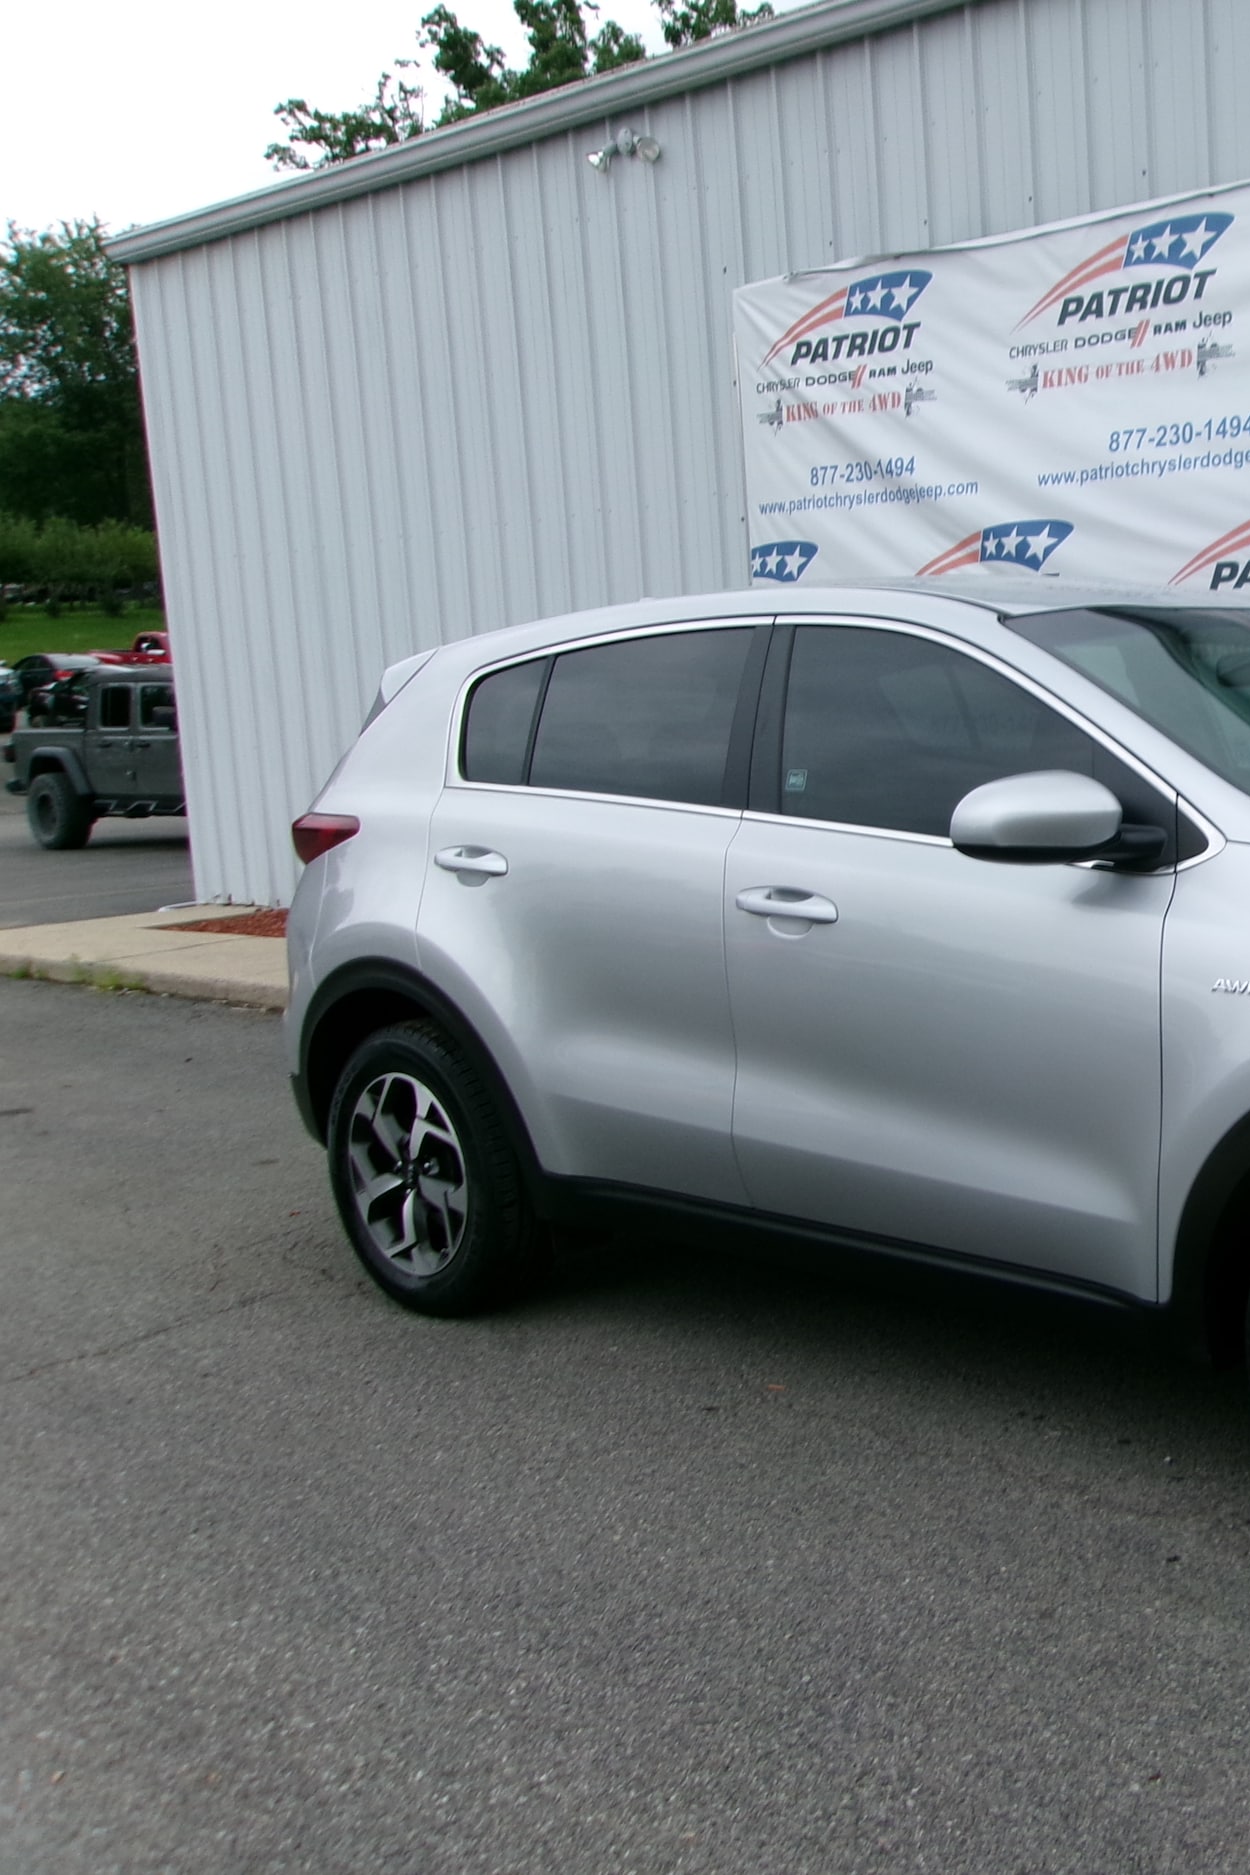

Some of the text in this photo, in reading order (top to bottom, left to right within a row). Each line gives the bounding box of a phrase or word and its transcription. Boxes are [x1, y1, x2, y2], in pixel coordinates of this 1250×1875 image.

[1057, 267, 1217, 326] PATRIOT
[790, 321, 921, 366] PATRIOT
[1009, 310, 1232, 360] CHRYSLER DODGE RAM Jeep
[805, 371, 856, 386] DODGE
[869, 366, 897, 379] RAM
[901, 359, 933, 376] Jeep
[1042, 349, 1193, 389] KING OF THE 4WD
[786, 391, 901, 422] KING OF THE 4WD
[810, 456, 915, 486] 877-230-1494
[759, 481, 978, 515] www.patriotchryslerdodgejeep.com
